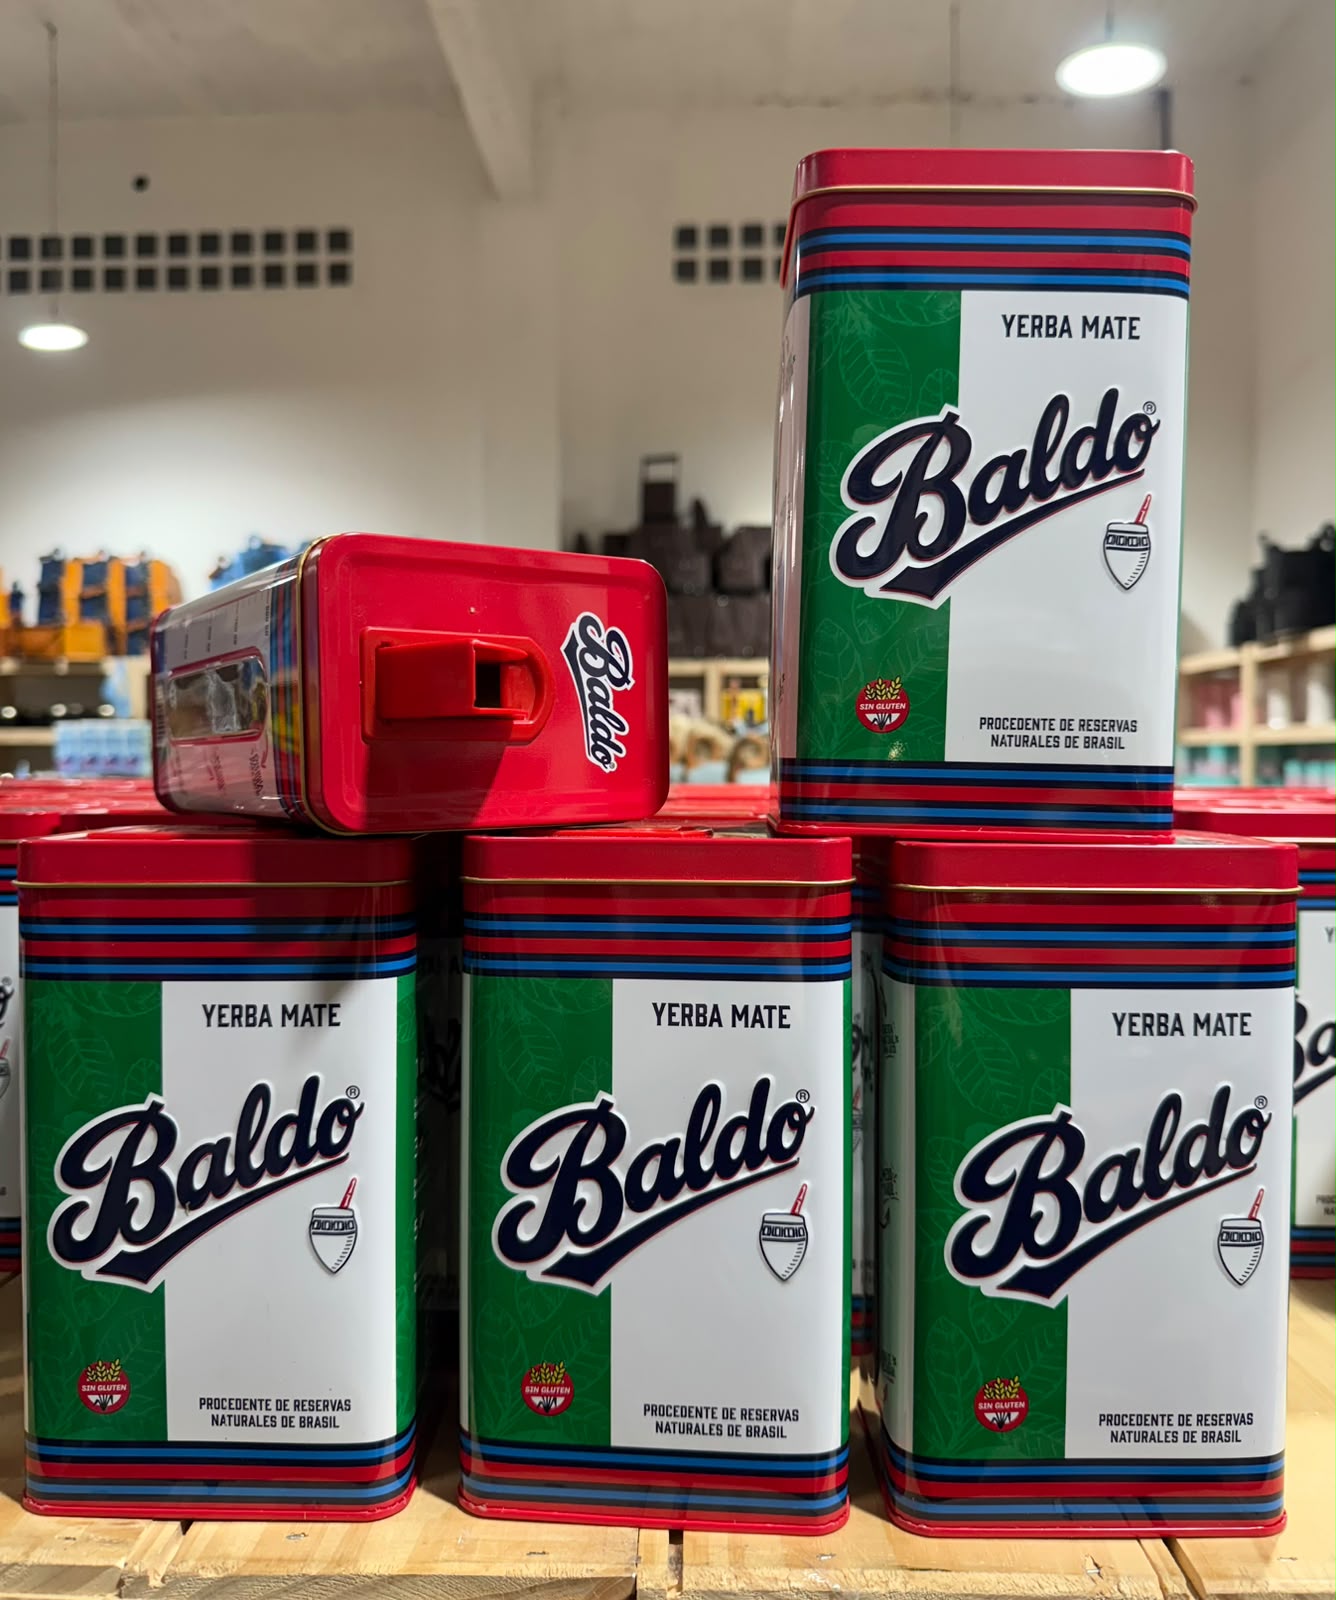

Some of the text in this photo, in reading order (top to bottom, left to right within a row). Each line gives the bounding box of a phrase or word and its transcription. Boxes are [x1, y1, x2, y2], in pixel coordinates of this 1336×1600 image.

[1000, 313, 1141, 341] YERBA MATE
[859, 702, 907, 711] SIN GLUTEN
[979, 716, 1138, 733] PROCEDENTE DE RESERVAS
[990, 733, 1126, 750] NATURALES DE BRASIL
[201, 1003, 342, 1028] YERBA MATE
[651, 1002, 791, 1030] YERBA MATE
[1111, 1012, 1253, 1037] YERBA MATE
[81, 1384, 96, 1392] SIN
[525, 1385, 571, 1395] SIN GLUTEN
[198, 1397, 352, 1412] PROCEDENTE DE RESERVAS
[643, 1403, 799, 1422] PROCEDENTE DE RESERVAS
[978, 1401, 1025, 1410] SIN GLUTEN
[210, 1413, 340, 1429] NATURALES DE BRASIL
[1098, 1412, 1254, 1427] PROCEDENTE DE RESERVAS
[655, 1421, 787, 1438] NATURALES DE BRASIL
[1110, 1429, 1242, 1444] NATURALES DE BRASIL
